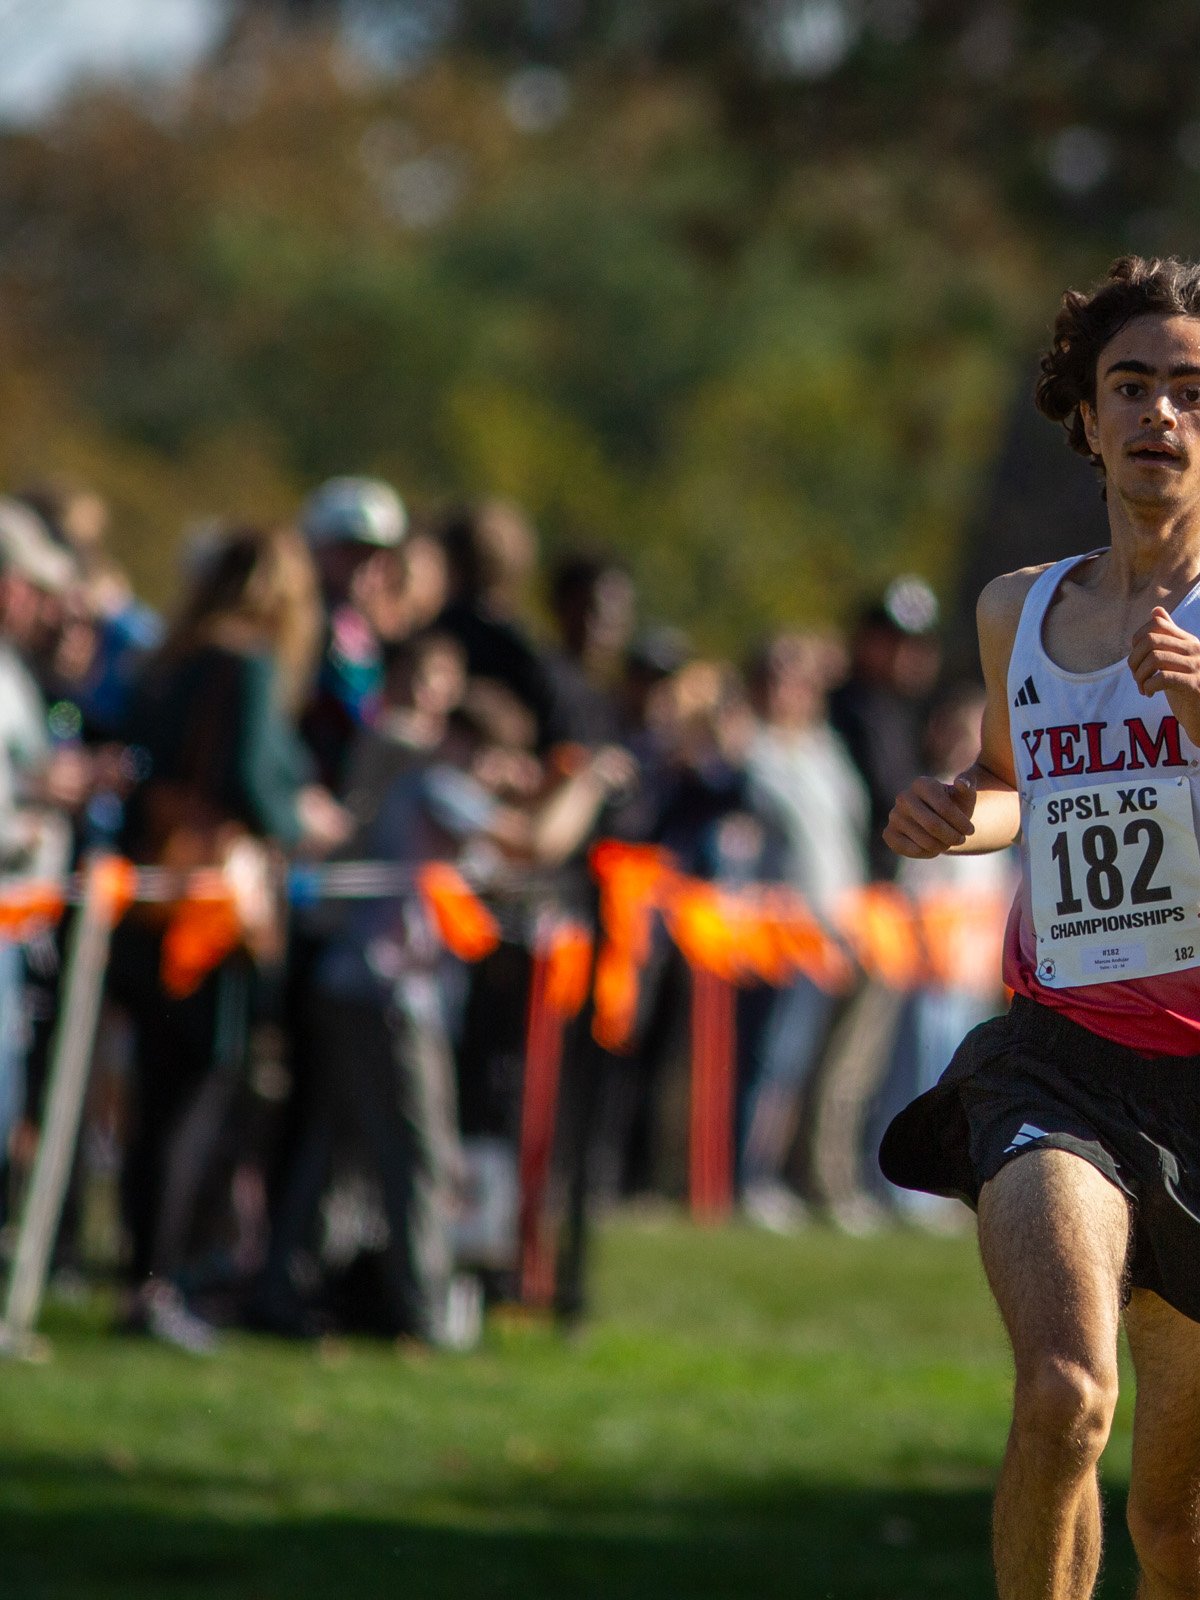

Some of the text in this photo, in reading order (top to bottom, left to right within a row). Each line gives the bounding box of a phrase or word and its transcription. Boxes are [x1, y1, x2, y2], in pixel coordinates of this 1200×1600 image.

[1021, 715, 1189, 782] YELM
[1046, 786, 1158, 825] SPSL XC
[1051, 818, 1172, 917] 182
[1050, 906, 1185, 940] CHAMPIONSHIPS
[1102, 948, 1119, 957] #182
[1174, 945, 1195, 962] 182
